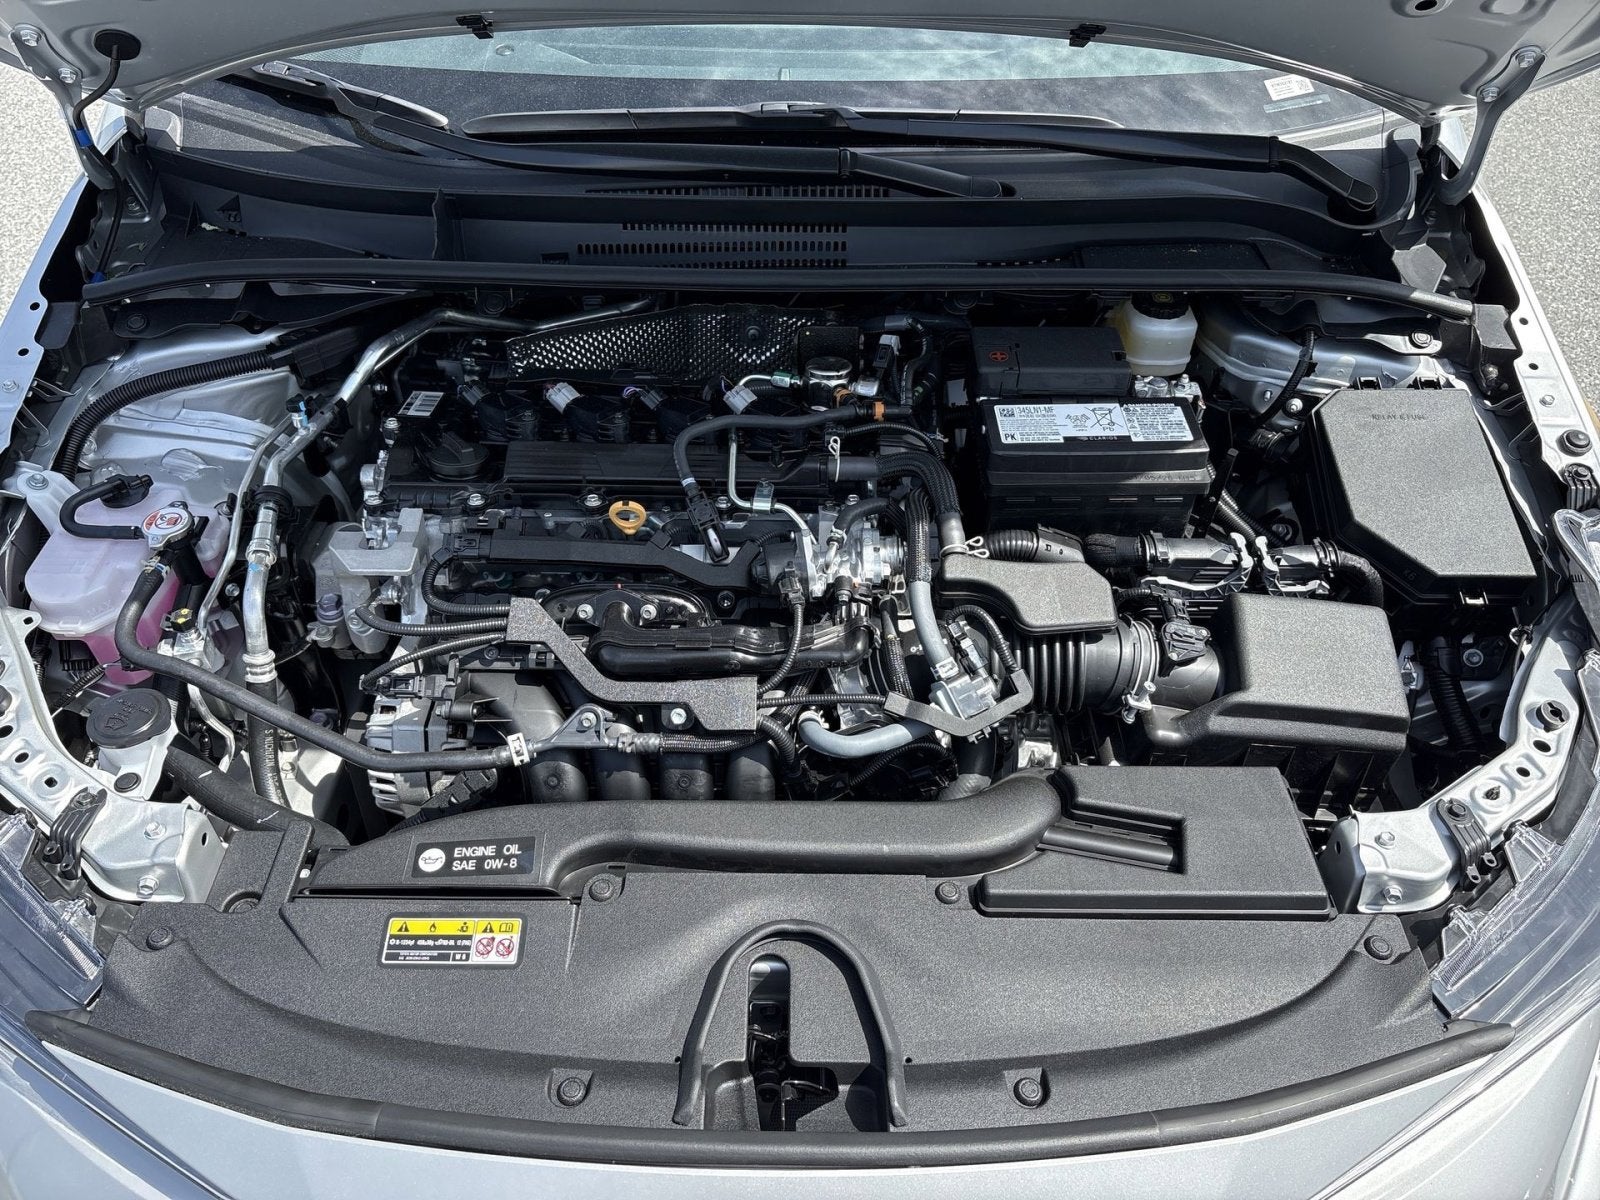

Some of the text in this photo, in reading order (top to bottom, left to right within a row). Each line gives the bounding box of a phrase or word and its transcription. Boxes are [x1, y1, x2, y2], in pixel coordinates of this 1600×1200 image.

[1004, 433, 1017, 441] PK
[453, 844, 522, 858] ENGINE OIL
[452, 858, 518, 871] SAE 0W-8
